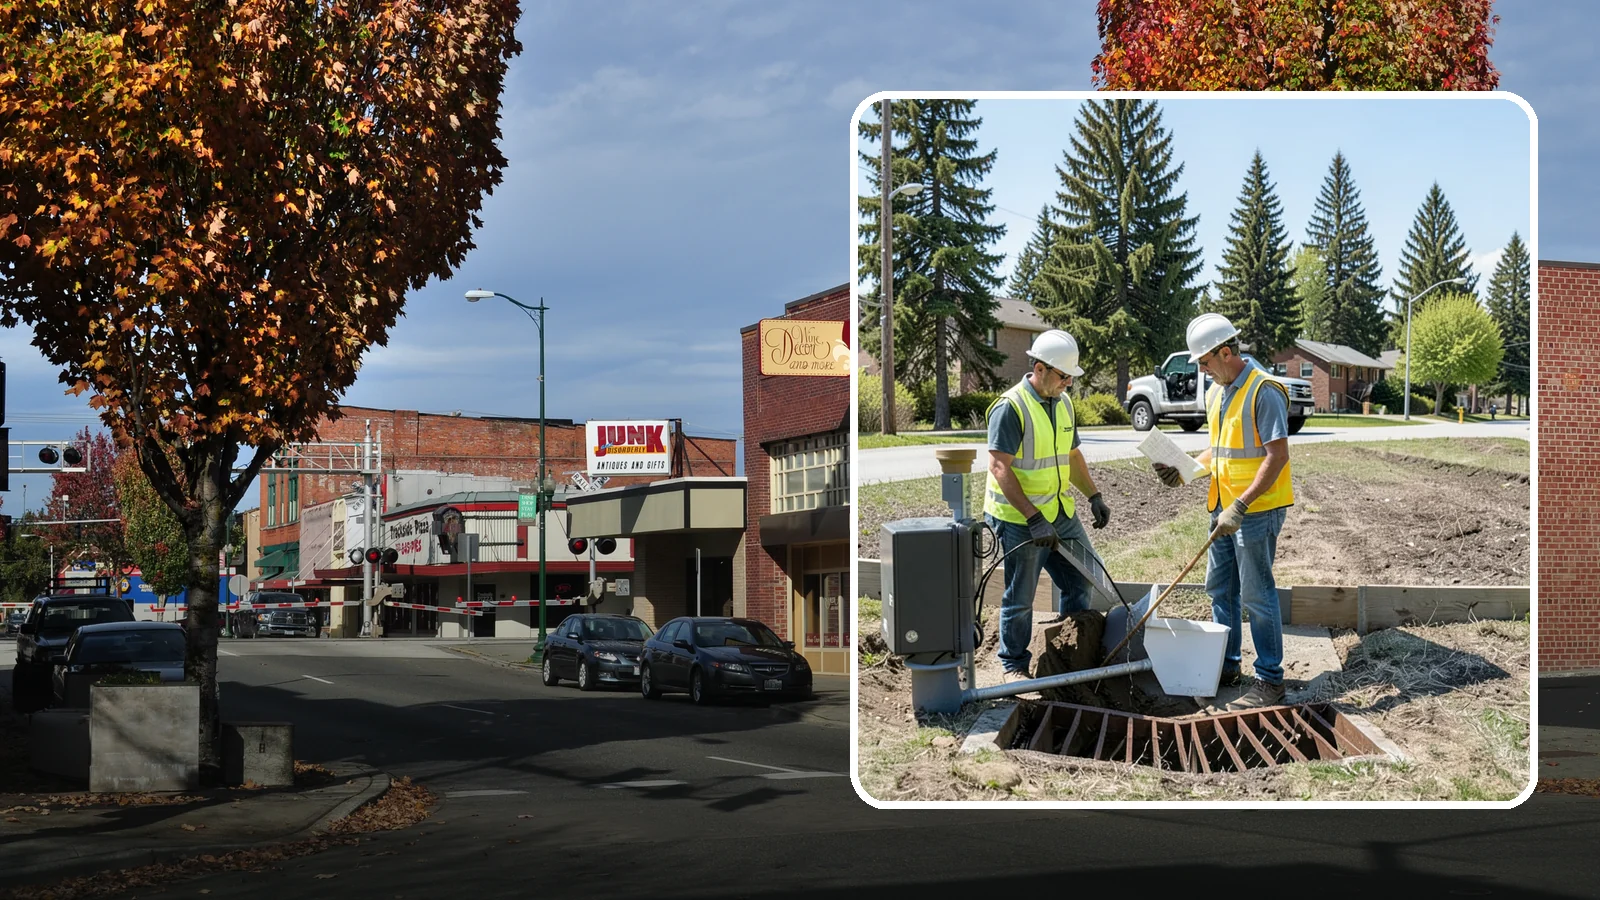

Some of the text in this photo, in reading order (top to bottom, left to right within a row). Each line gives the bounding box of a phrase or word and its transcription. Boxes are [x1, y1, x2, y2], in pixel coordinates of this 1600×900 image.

[595, 425, 665, 457] JUNK
[597, 460, 665, 470] ANTIQUES AND GIFTS
[415, 519, 429, 535] Pizza
